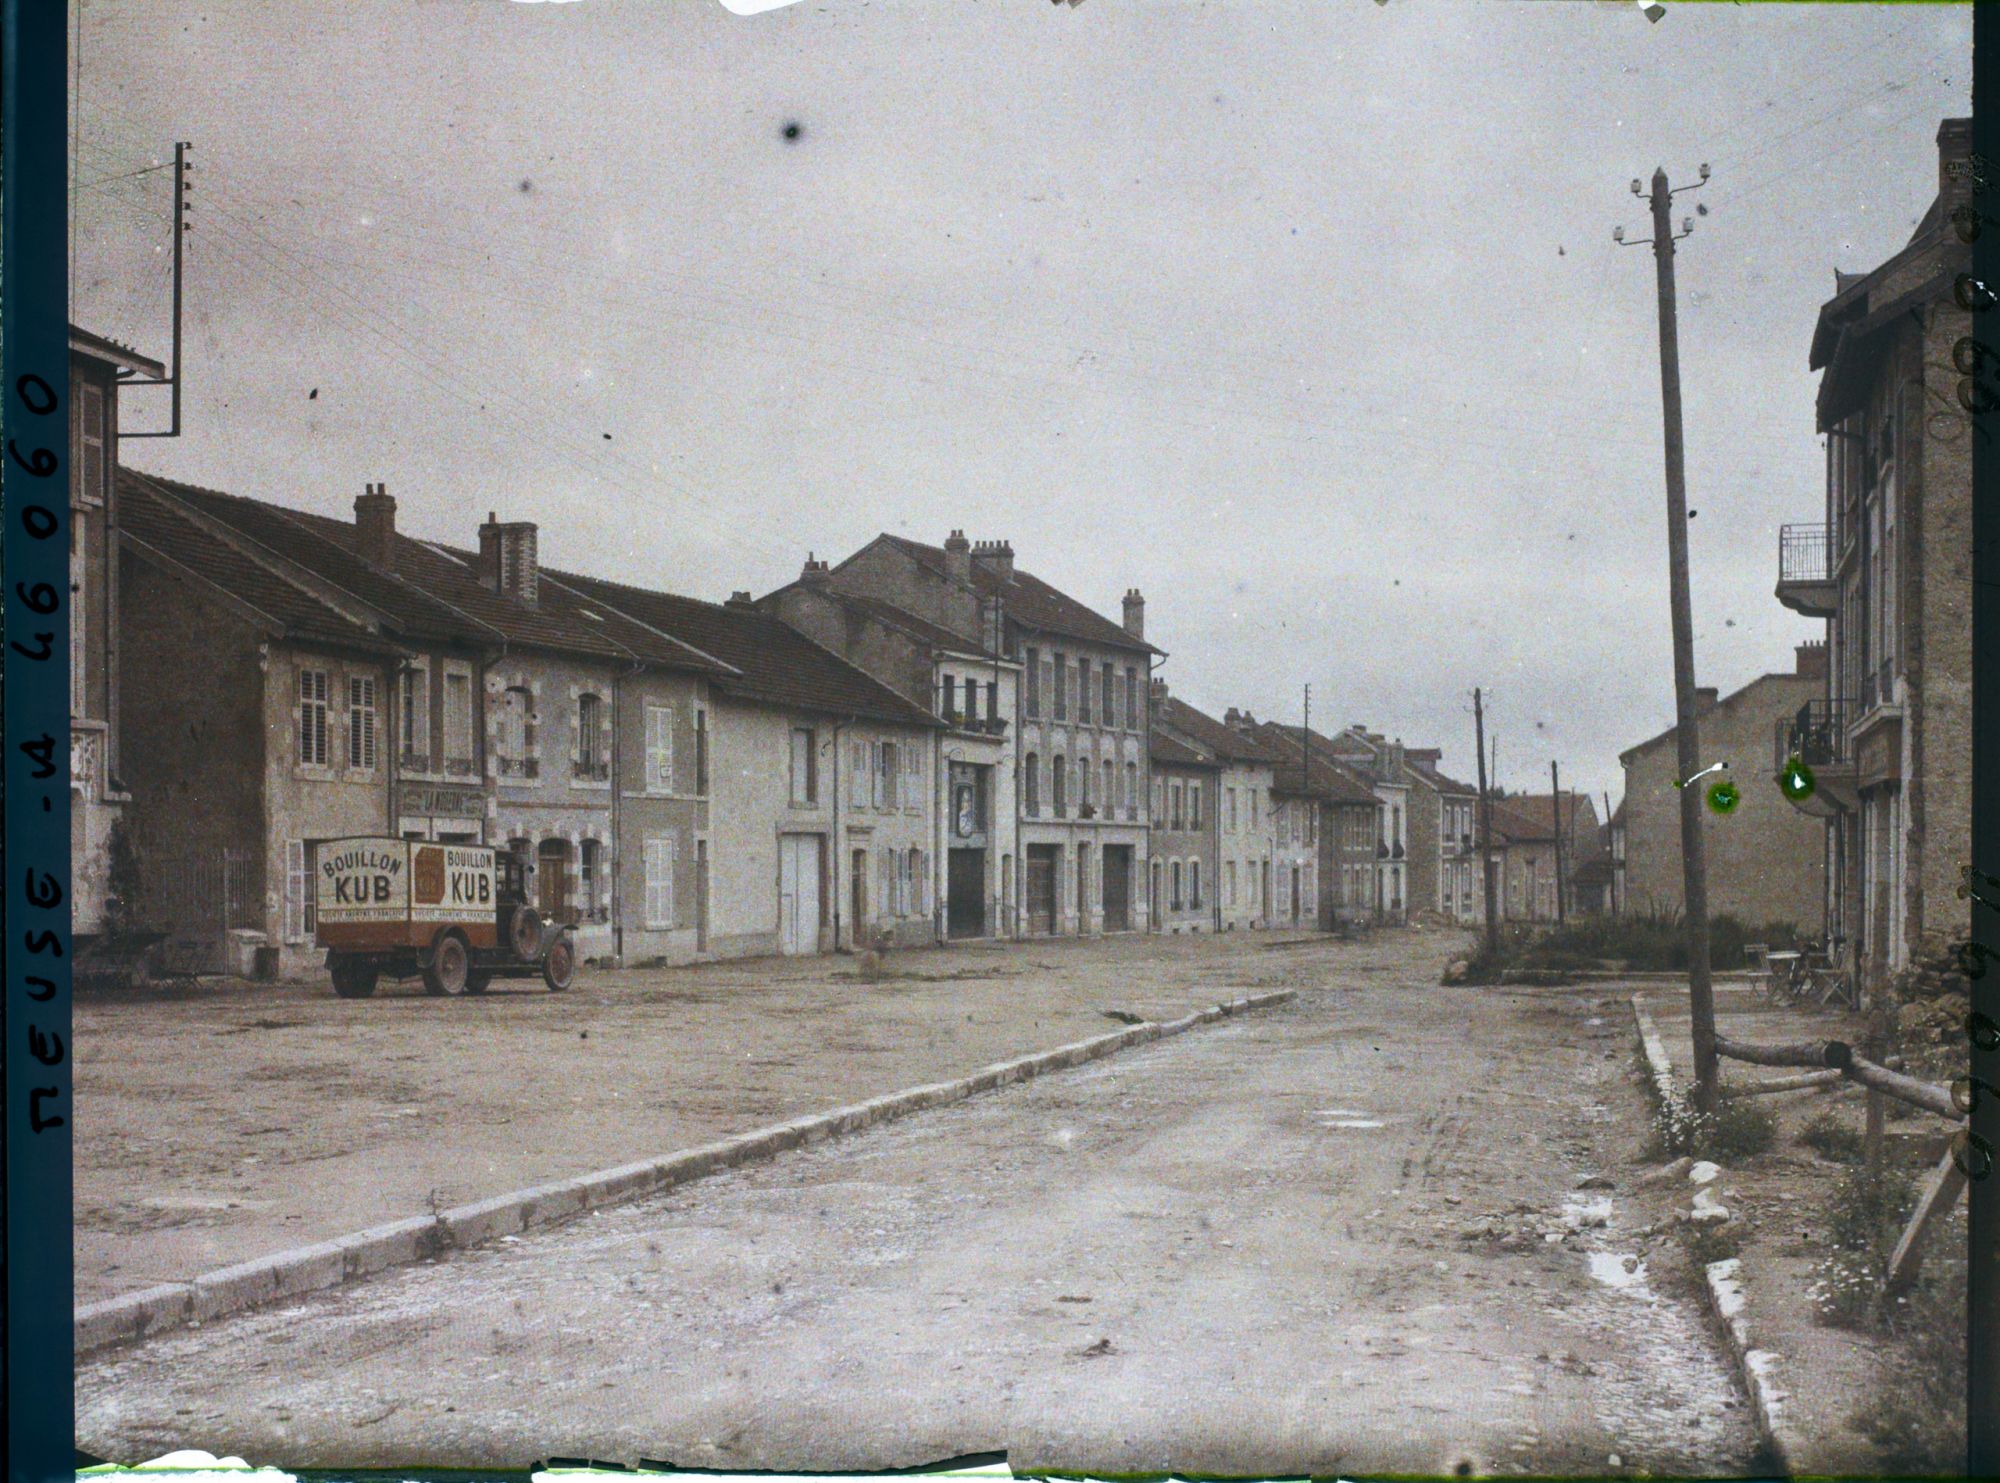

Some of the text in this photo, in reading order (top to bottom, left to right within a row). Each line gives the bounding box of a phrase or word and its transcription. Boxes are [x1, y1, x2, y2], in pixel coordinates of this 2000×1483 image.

[322, 851, 402, 878] BOUILLON
[447, 850, 492, 869] BOUILLON
[335, 874, 391, 904] KUB
[451, 871, 490, 904] KUB
[25, 868, 65, 1134] MEUSE
